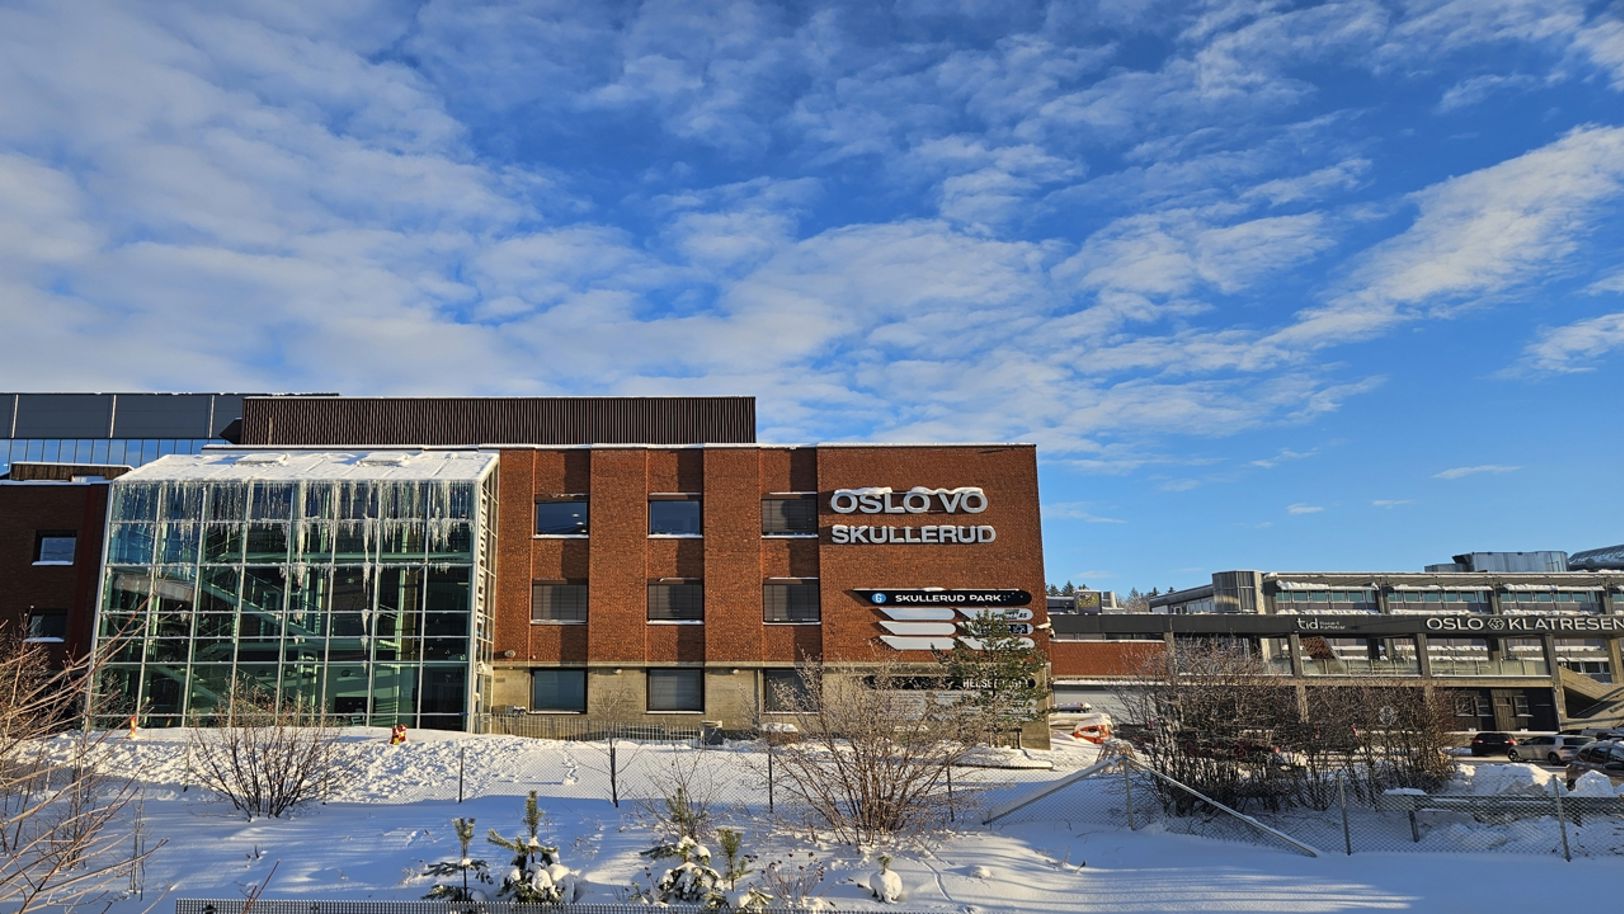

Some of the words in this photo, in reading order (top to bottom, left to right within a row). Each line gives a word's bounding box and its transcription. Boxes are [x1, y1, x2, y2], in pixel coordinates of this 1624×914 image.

[830, 490, 931, 515] OSLO
[938, 490, 989, 515] VO
[831, 524, 997, 545] SKULLERUD
[894, 593, 966, 603] SKULLERUD
[969, 593, 1001, 603] PARK
[1296, 617, 1319, 630] tid
[1426, 617, 1484, 631] OSLO
